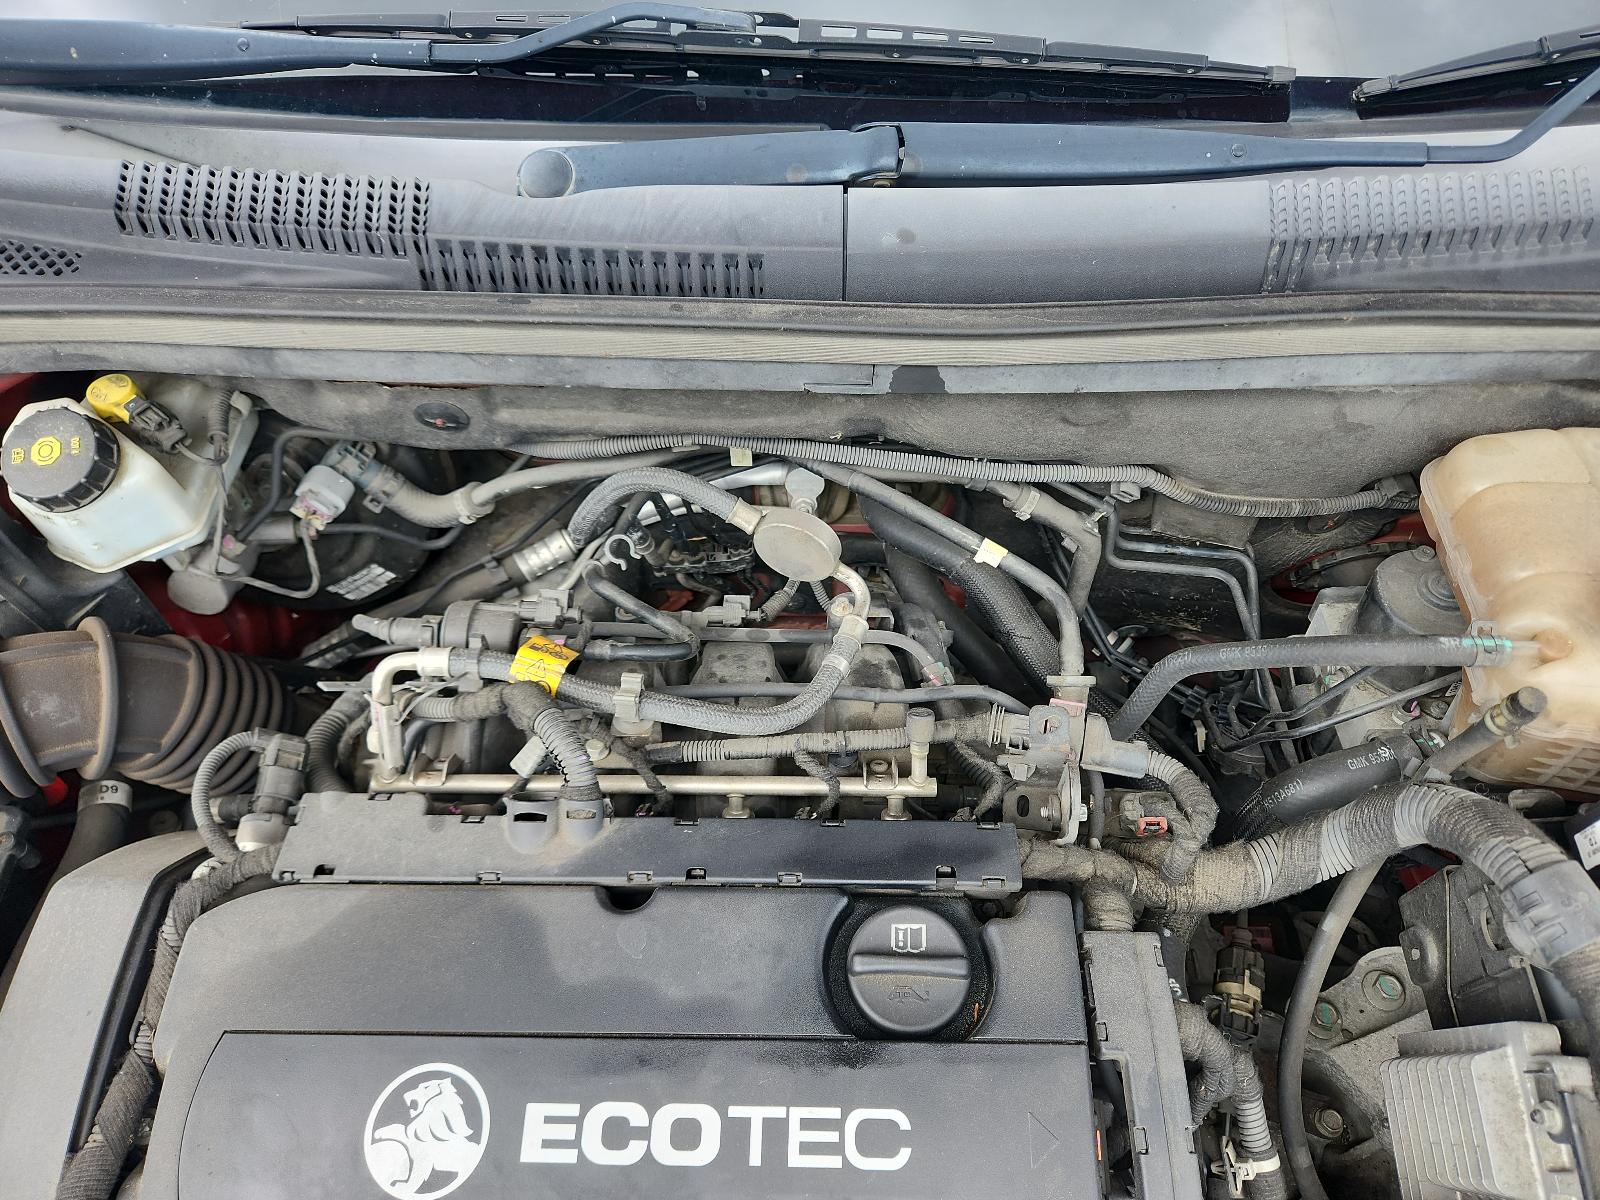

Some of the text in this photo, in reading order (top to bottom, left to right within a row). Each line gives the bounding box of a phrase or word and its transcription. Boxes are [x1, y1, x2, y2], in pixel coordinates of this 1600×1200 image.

[1347, 755, 1370, 770] GMK
[100, 784, 119, 794] D9
[520, 1101, 912, 1171] ECOTEC
